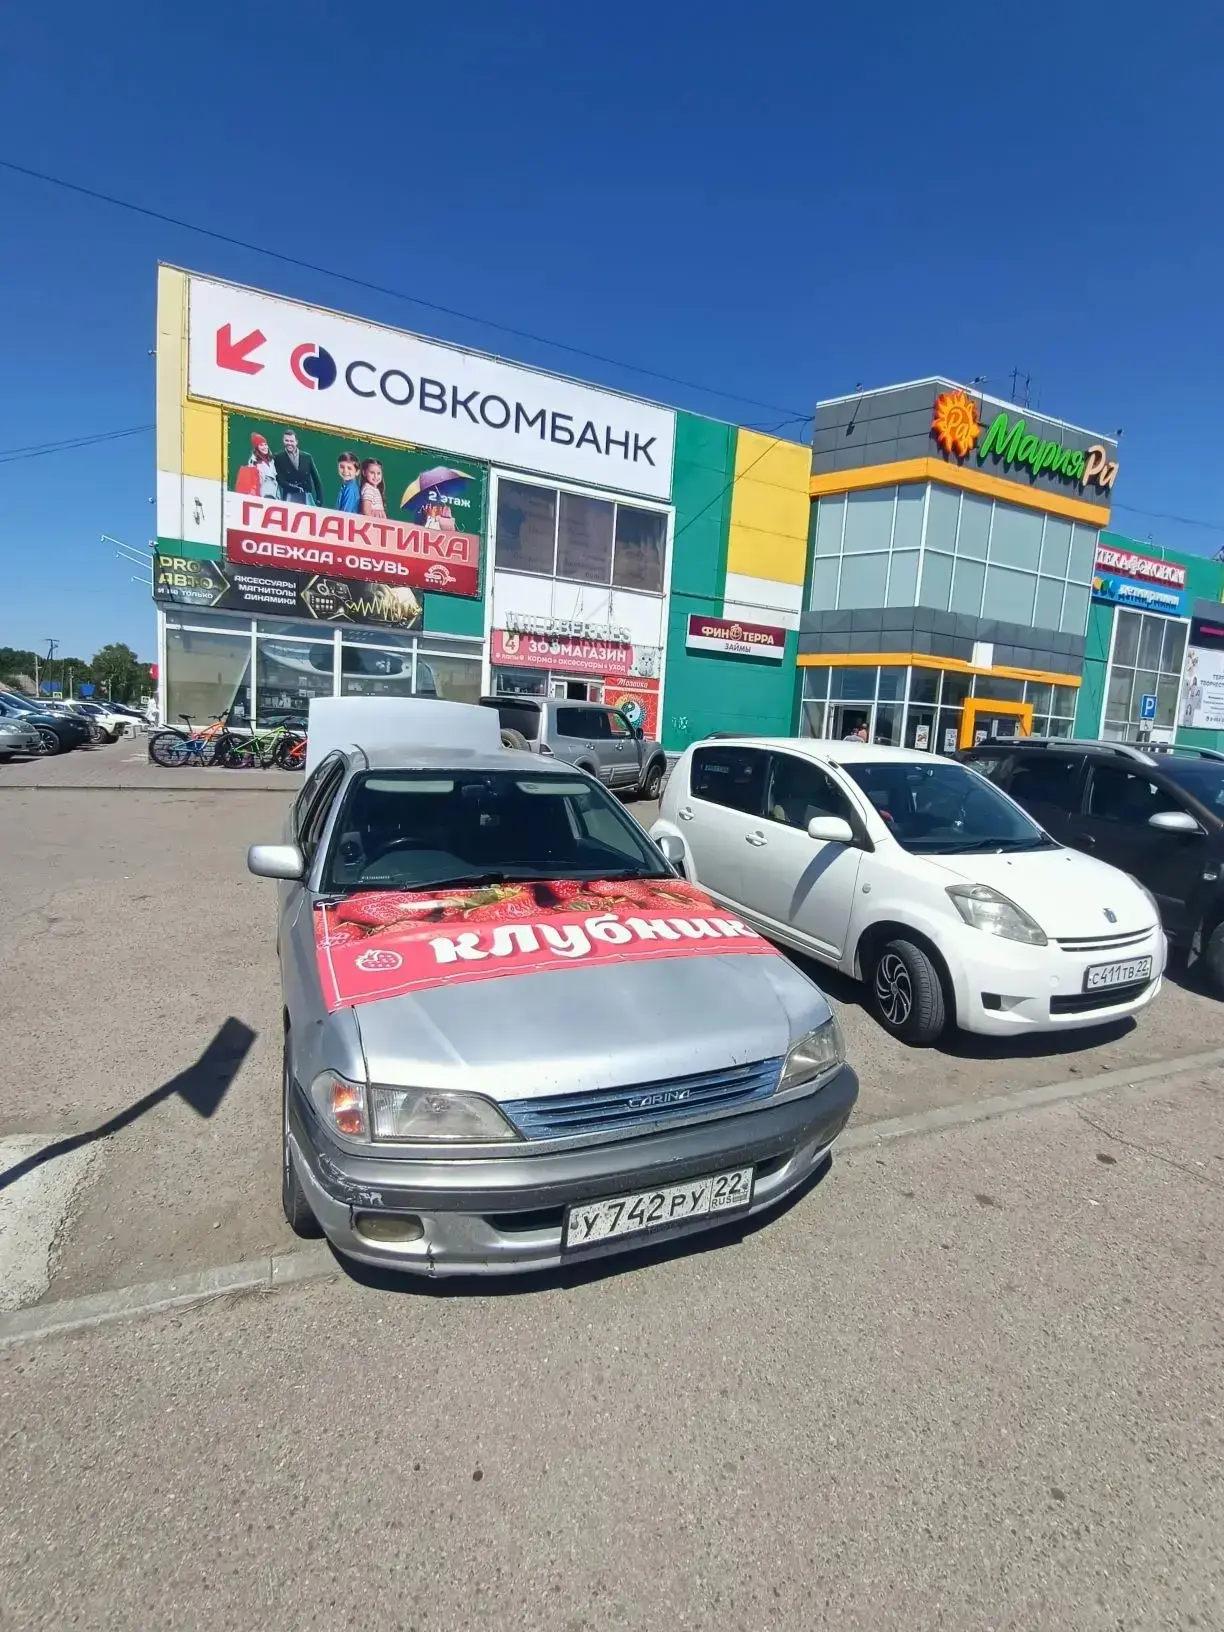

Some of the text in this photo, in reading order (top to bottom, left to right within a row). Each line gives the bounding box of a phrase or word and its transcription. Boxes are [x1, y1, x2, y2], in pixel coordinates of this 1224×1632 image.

[344, 359, 658, 467] СОВКОМБАНК
[428, 490, 471, 509] 2 этаж
[241, 500, 470, 562] ГАЛАКТИКА
[241, 539, 335, 566] ОДЕЖДА
[345, 556, 410, 577] ОБУВЬ
[233, 574, 297, 590] АКСЕССУАРЫ
[238, 583, 297, 598] МАГНИТОЛЫ
[182, 591, 213, 599] только
[243, 593, 297, 606] ДИНАМИКИ
[702, 626, 775, 645] ФИН ТЕРРА
[529, 640, 626, 662] ЗООМАГАЗИН
[724, 642, 752, 654] ЗАЙМЫ
[527, 655, 627, 673] корма аксессуары уход
[1136, 960, 1147, 972] 22
[628, 1088, 692, 1109] CARINA
[583, 1173, 742, 1239] У742РУ 22
[711, 1195, 732, 1208] RUS
